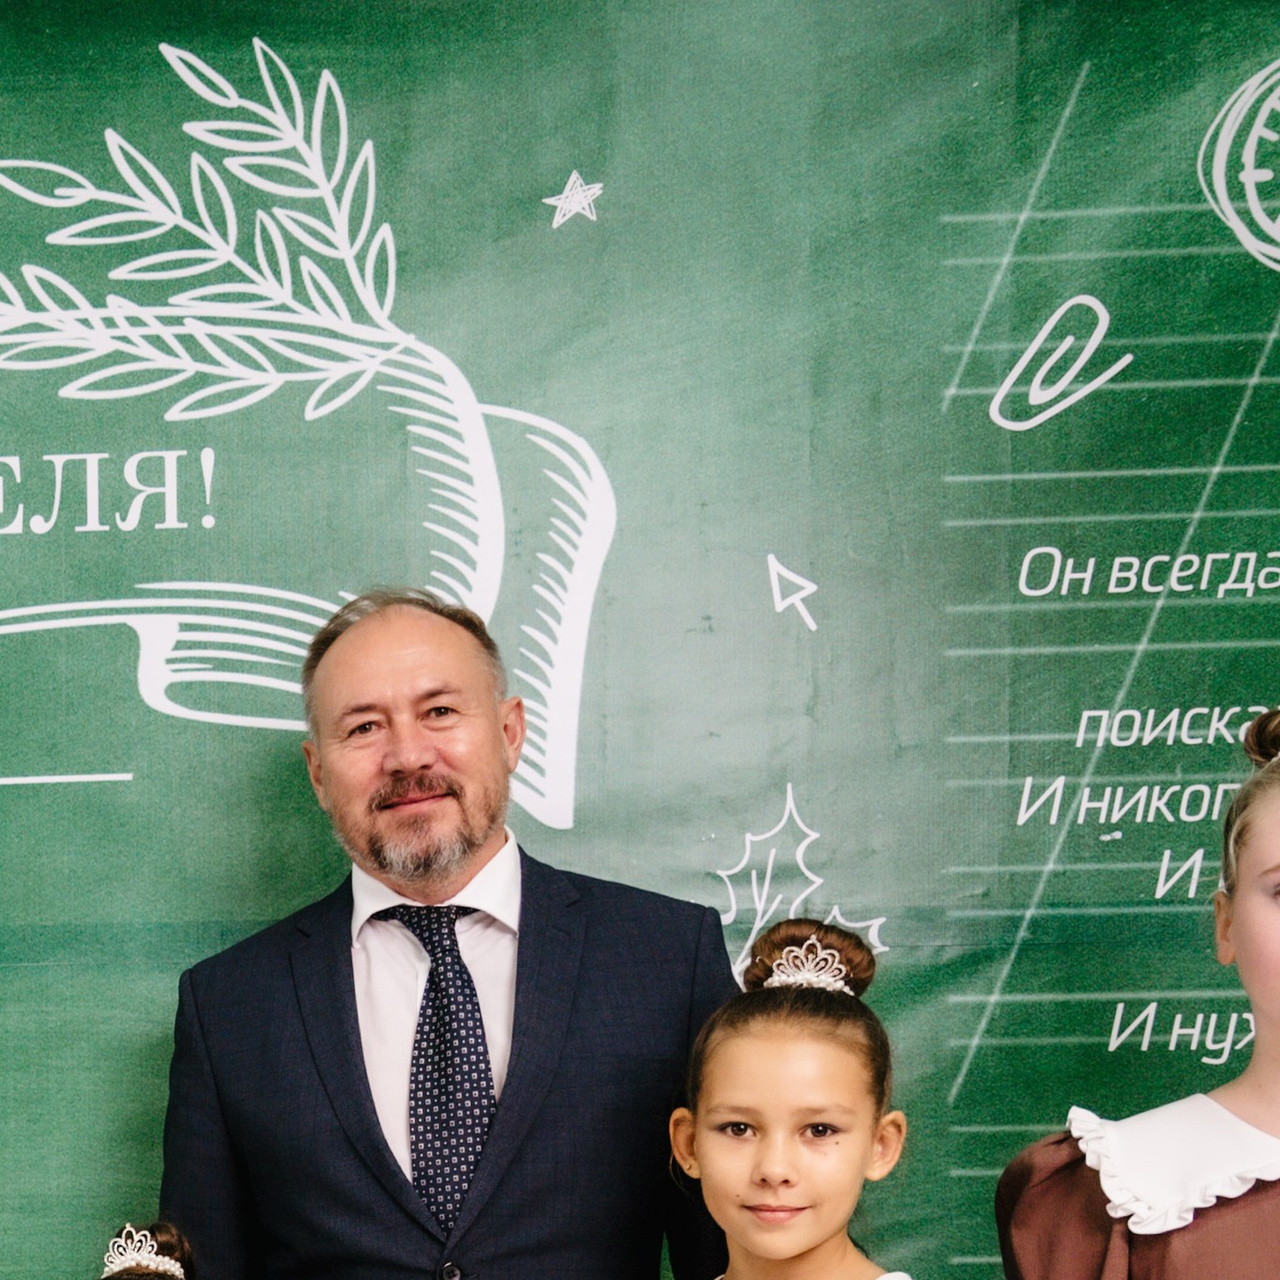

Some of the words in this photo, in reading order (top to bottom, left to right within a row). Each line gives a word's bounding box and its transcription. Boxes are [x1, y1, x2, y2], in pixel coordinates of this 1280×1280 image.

[1018, 546, 1095, 597] Он
[1108, 551, 1280, 599] всегда
[1016, 775, 1066, 826] И
[1154, 848, 1204, 899] И
[1108, 1002, 1157, 1052] И
